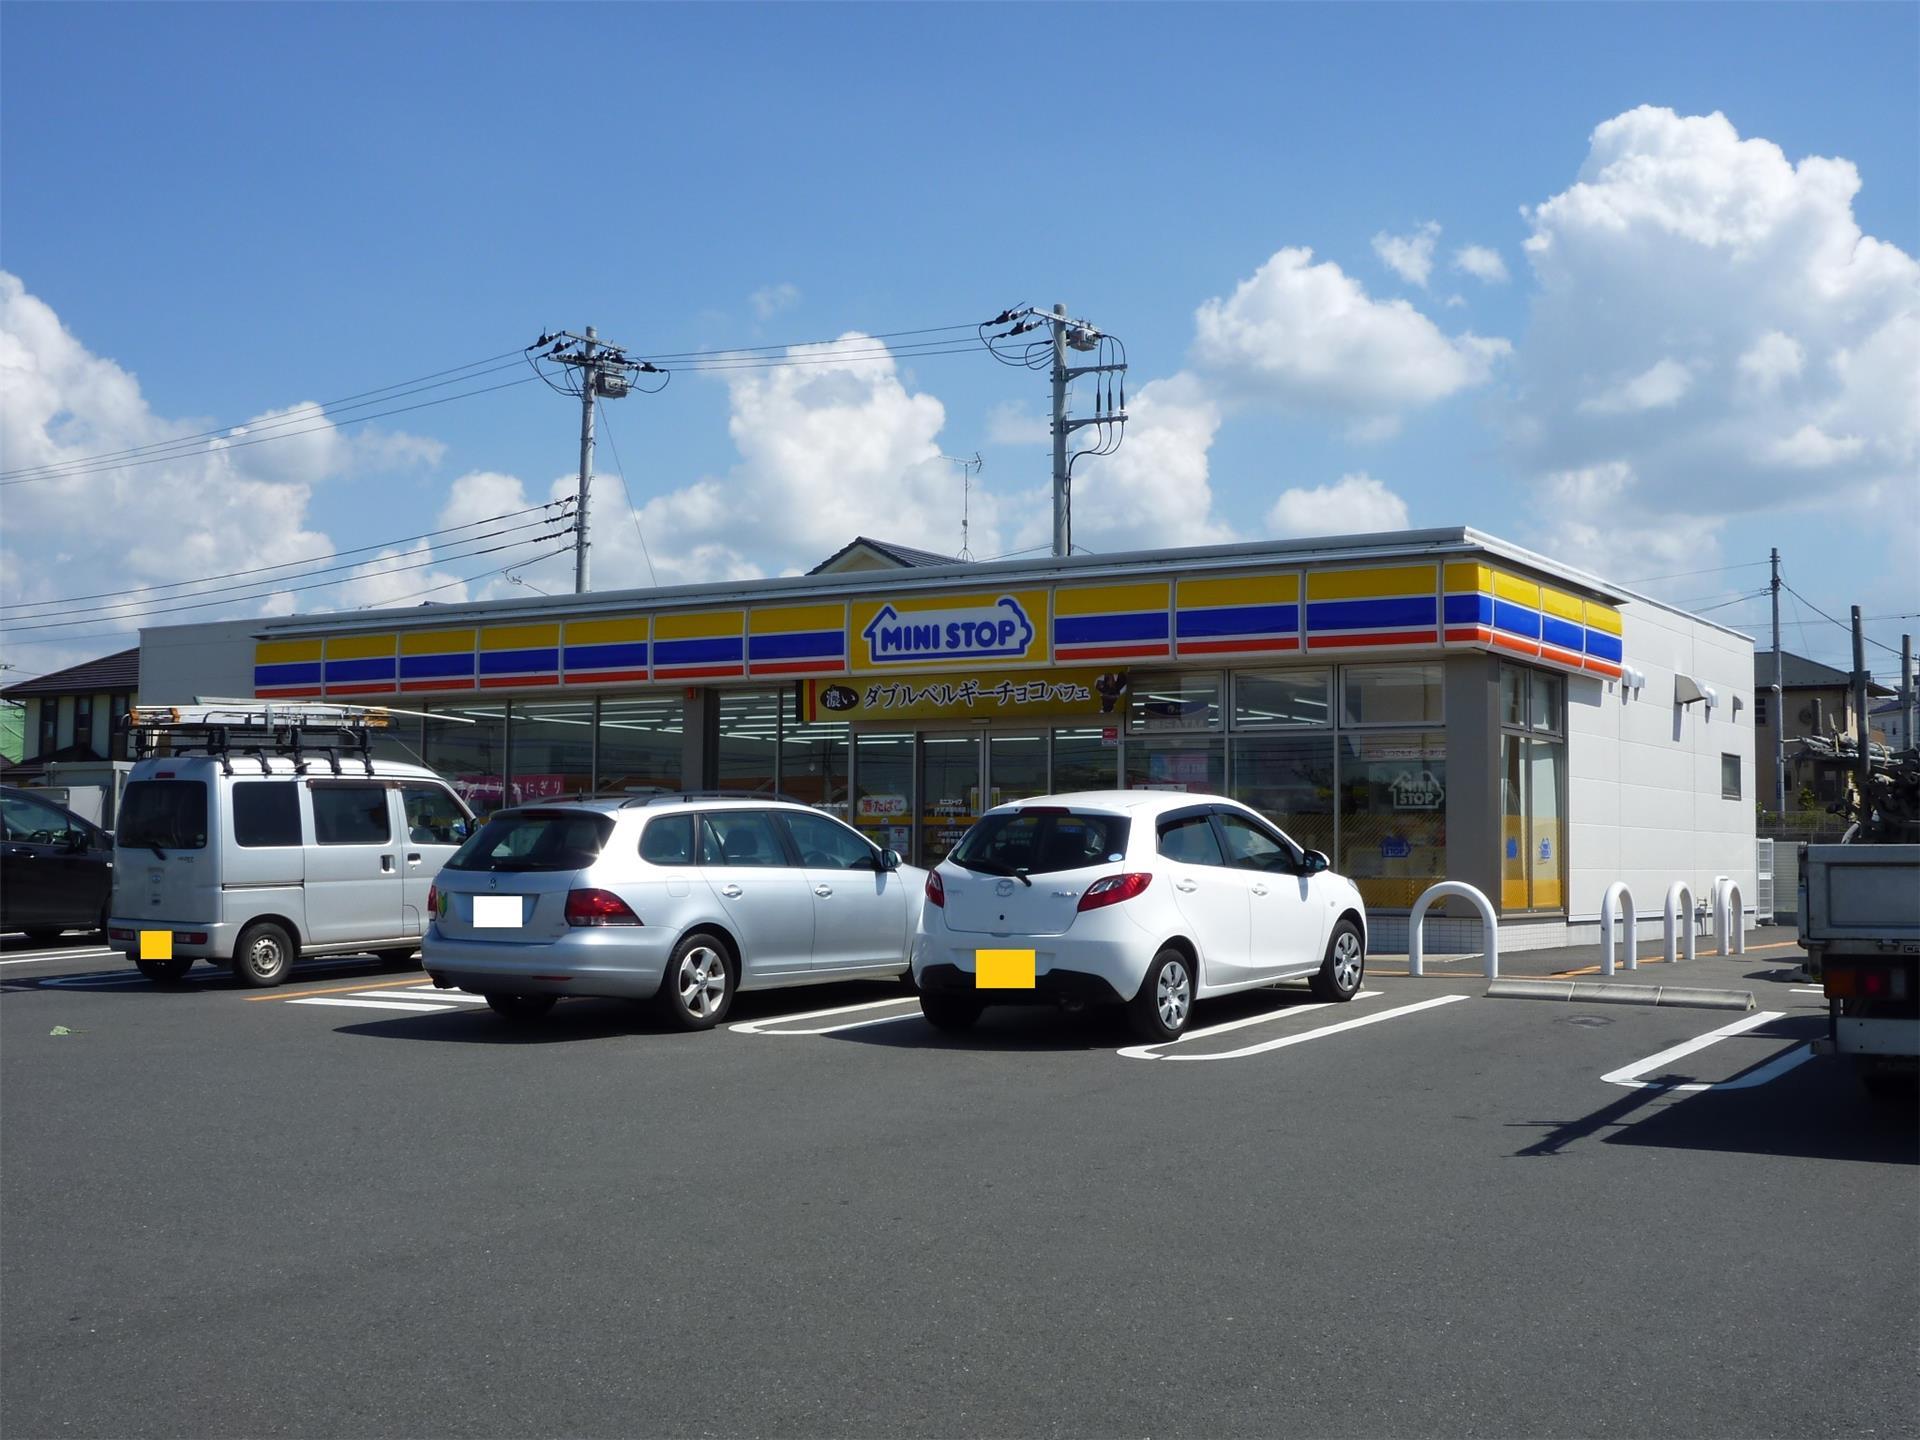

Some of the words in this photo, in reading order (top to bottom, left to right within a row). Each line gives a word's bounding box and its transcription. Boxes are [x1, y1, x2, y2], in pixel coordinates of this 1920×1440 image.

[880, 621, 941, 652] MINI
[945, 619, 1016, 650] STOP
[825, 689, 856, 708] 濃い
[863, 679, 1091, 708] ダブルベルギーチョコパフェ
[1400, 781, 1433, 792] MINI
[1400, 792, 1435, 804] STOP
